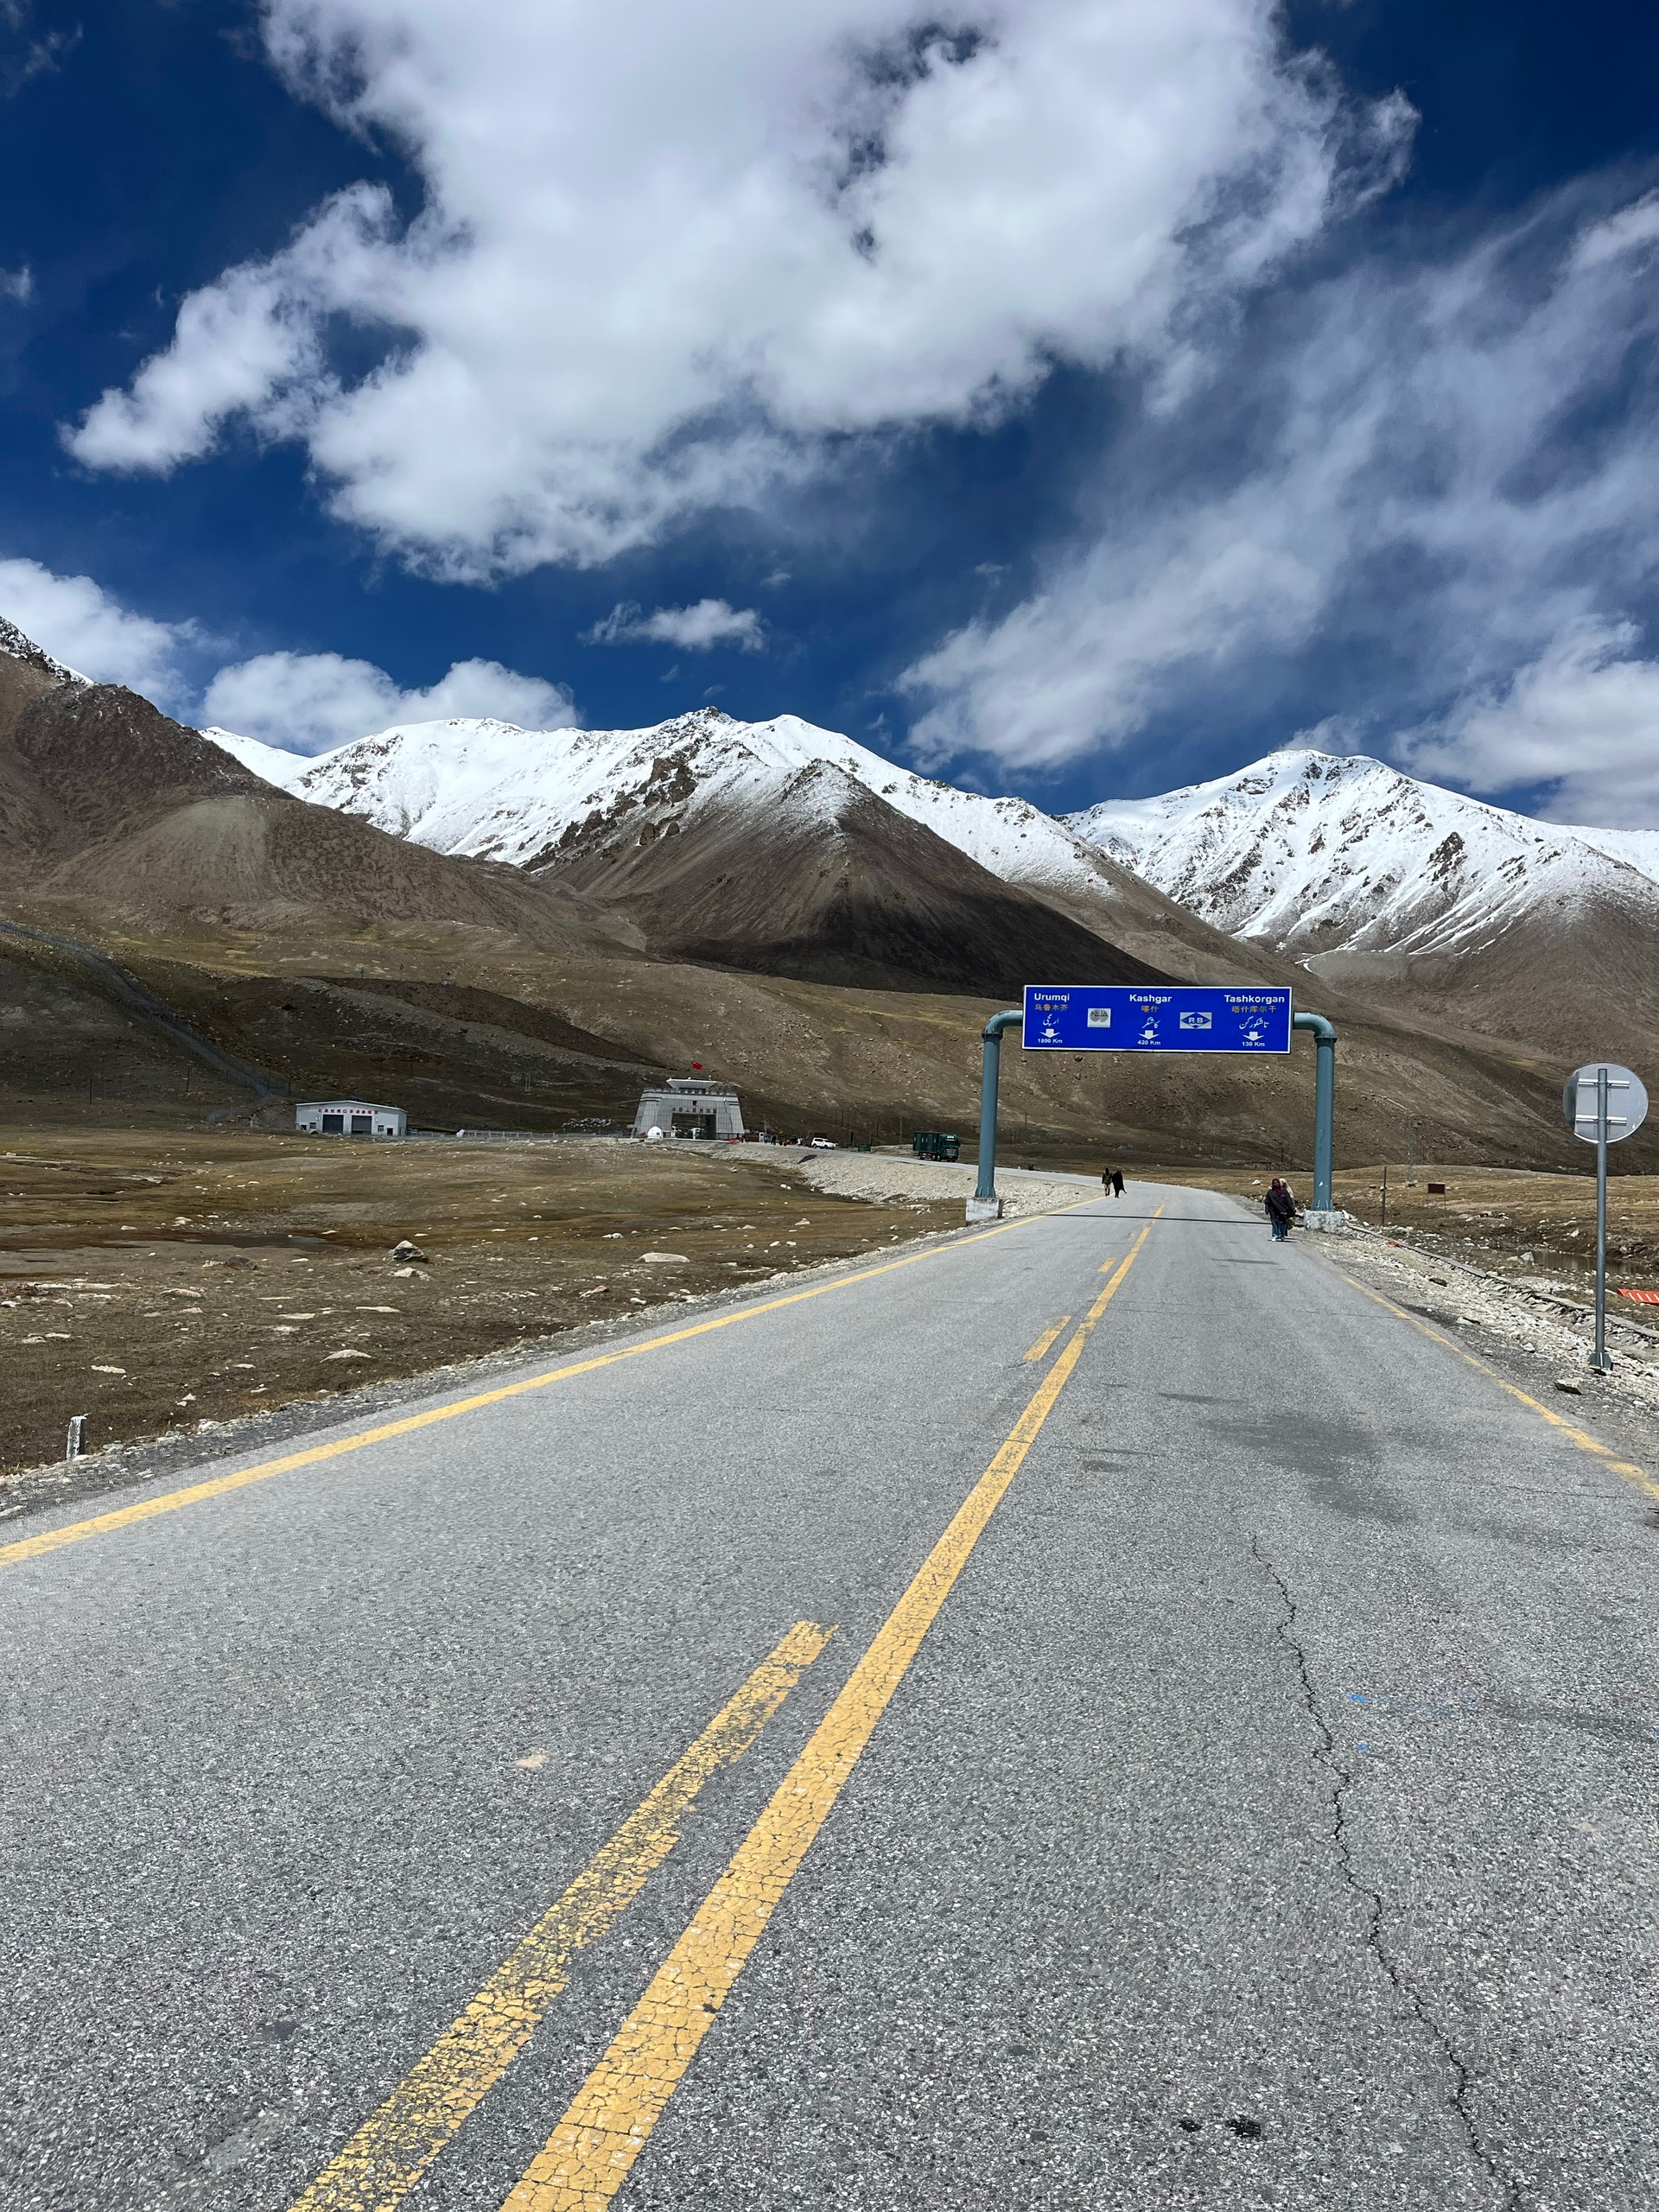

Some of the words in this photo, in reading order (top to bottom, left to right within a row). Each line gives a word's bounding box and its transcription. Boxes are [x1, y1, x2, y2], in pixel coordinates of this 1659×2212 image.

[1034, 993, 1070, 1002] Urumqi
[1129, 994, 1173, 1004] Kashgar
[1224, 995, 1285, 1005] Tashkorgan
